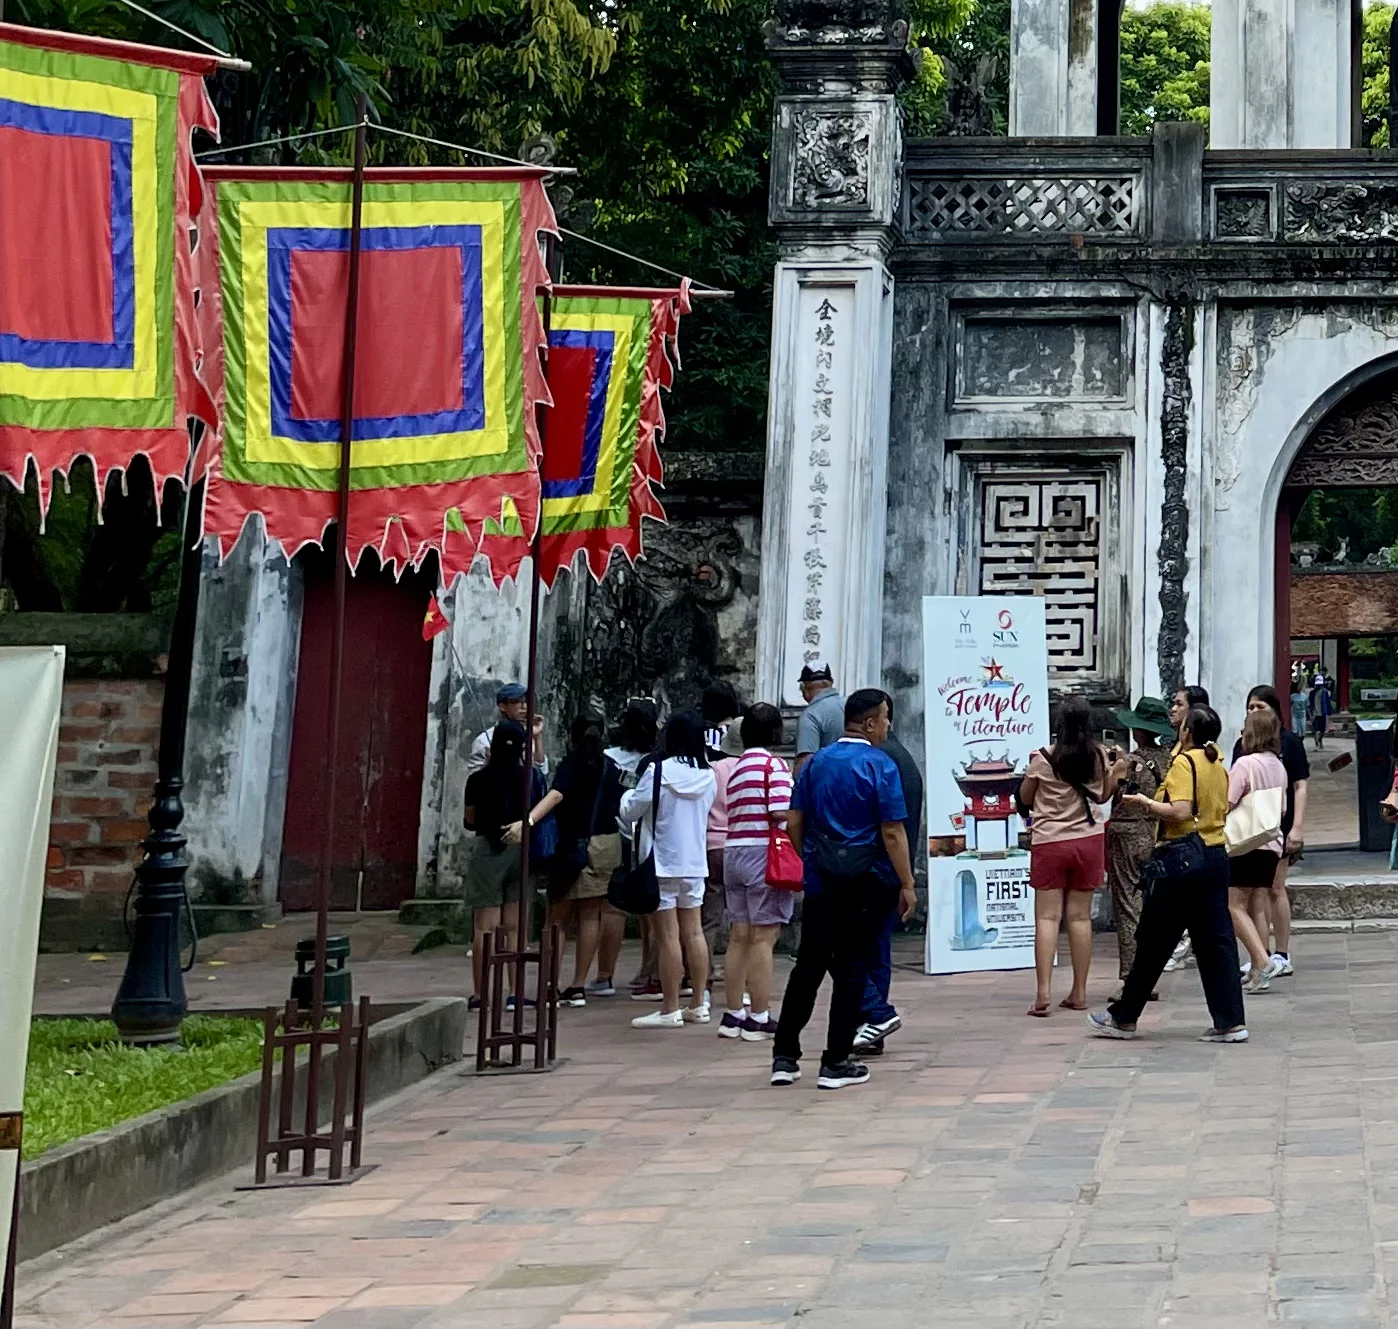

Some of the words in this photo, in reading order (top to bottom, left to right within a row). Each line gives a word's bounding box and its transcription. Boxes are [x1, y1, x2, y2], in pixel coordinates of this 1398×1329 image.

[992, 630, 1019, 642] SUN
[947, 683, 1032, 722] Temple
[963, 717, 1034, 737] Literature
[986, 880, 1031, 901] FIRST
